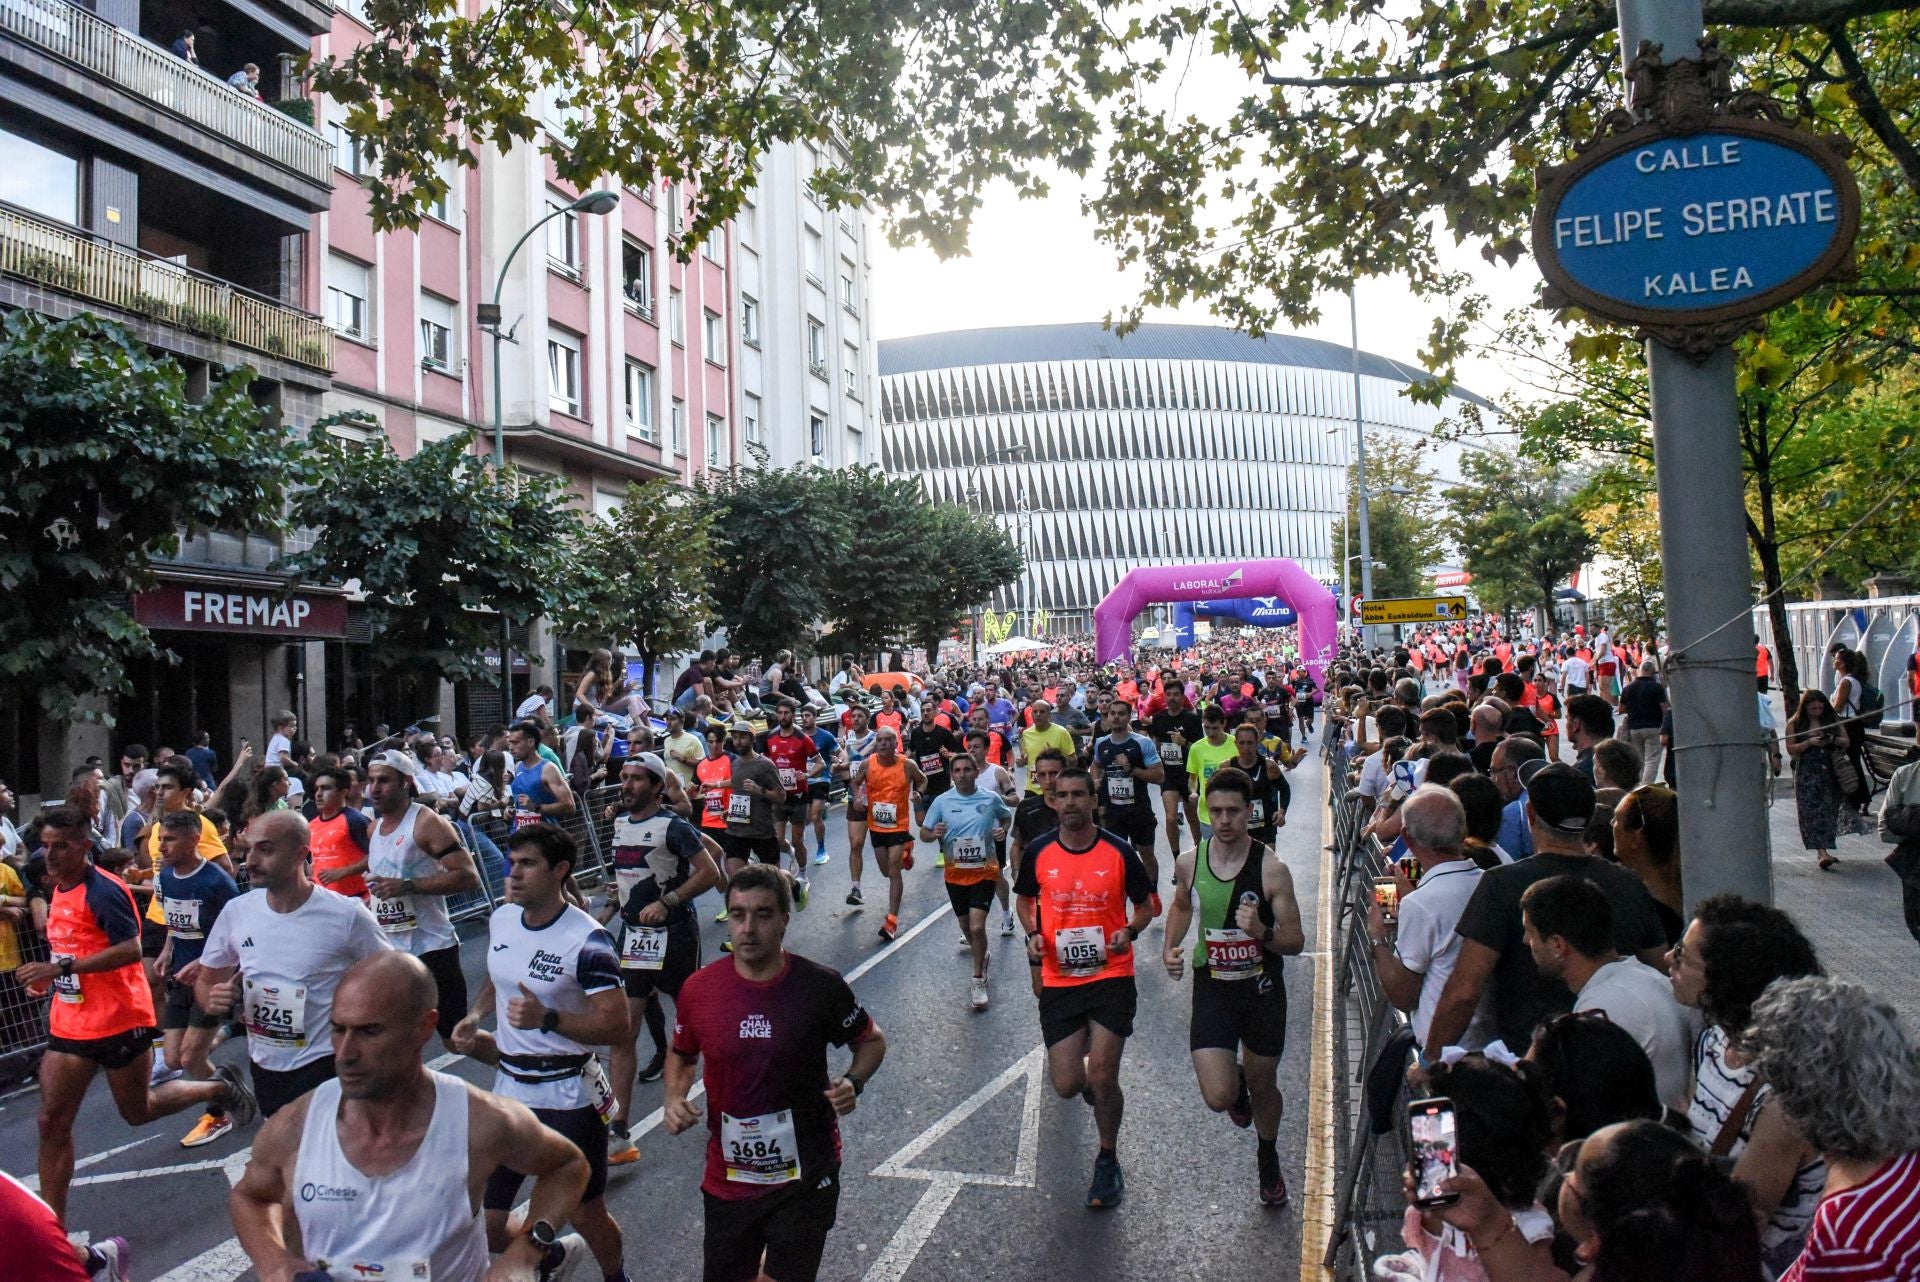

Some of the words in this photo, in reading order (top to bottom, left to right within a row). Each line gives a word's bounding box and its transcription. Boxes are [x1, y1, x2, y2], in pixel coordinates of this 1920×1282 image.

[1635, 140, 1742, 174] CALLE
[1555, 207, 1664, 250] FELIPE
[1681, 188, 1837, 237] SERRATE
[1644, 265, 1754, 297] KALEA
[1173, 579, 1220, 591] LABORAL
[1436, 574, 1465, 586] NERVIT
[184, 590, 311, 628] FREMAP
[1251, 605, 1290, 617] MIZUNO
[1363, 604, 1385, 612] Hotel
[1364, 613, 1384, 621] Abba
[1387, 611, 1433, 620] Euskalduna
[958, 846, 981, 856] 1997
[376, 900, 405, 914] 4830
[168, 912, 192, 924] 2287
[630, 939, 660, 951] 2414
[1063, 944, 1098, 959] 1055
[533, 950, 562, 964] Pata
[1210, 945, 1257, 960] 21008
[528, 959, 564, 975] Negra
[253, 1004, 293, 1025] 2245
[740, 1020, 772, 1030] CHALL
[739, 1028, 772, 1039] ENGE
[730, 1138, 781, 1158] 3684
[317, 1185, 357, 1197] Cinesis
